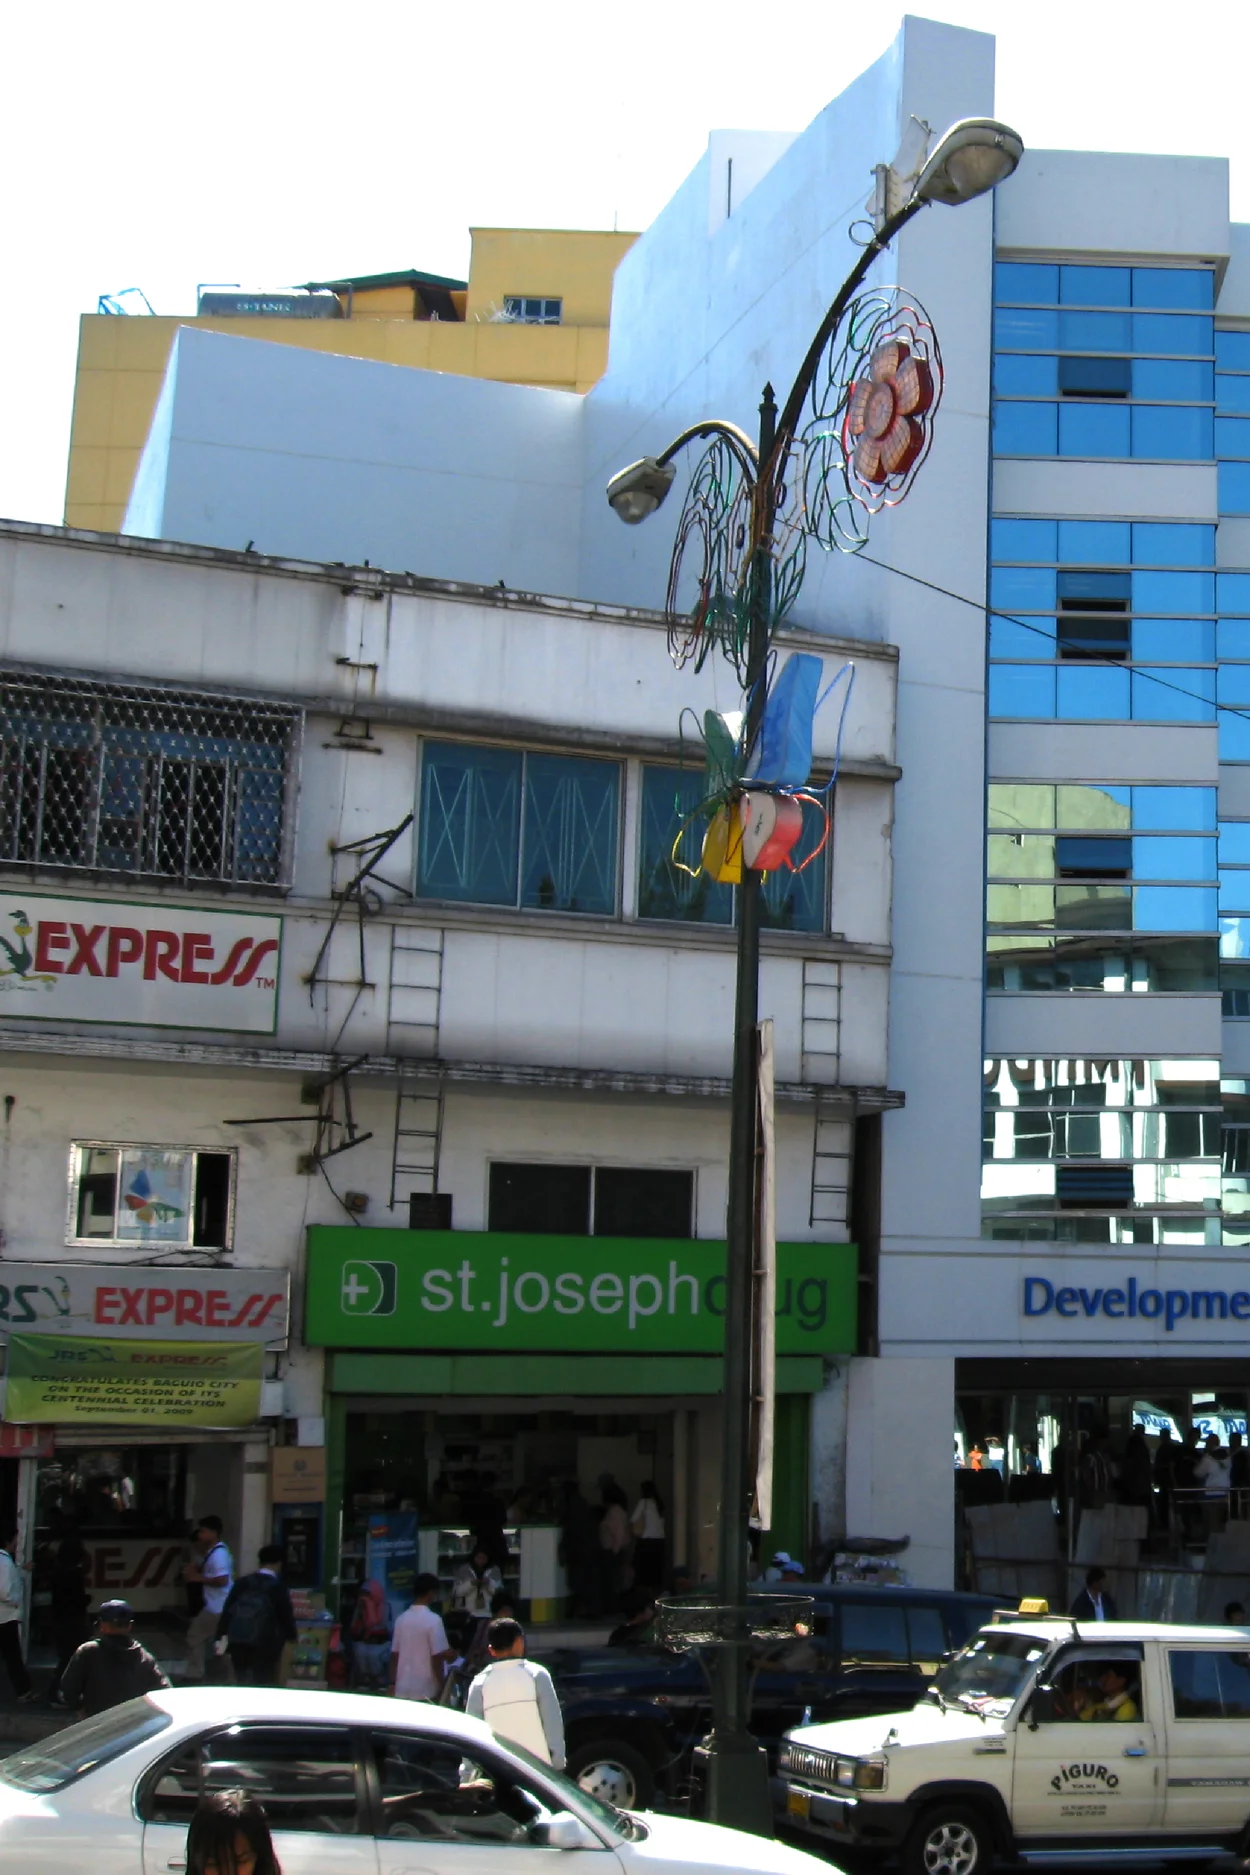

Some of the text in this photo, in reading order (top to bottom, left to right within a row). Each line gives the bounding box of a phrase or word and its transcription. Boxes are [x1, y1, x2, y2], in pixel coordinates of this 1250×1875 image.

[34, 920, 278, 987] EXPRESS
[93, 1286, 284, 1328] EXPRESS
[48, 1350, 228, 1367] JRS EXPRESS
[31, 1374, 239, 1389] CONGRATULATES BAGUIO CITY
[48, 1385, 222, 1398] ON THE OCCASION OF ITS
[41, 1394, 226, 1408] CENTENNIAL CELEBRATION
